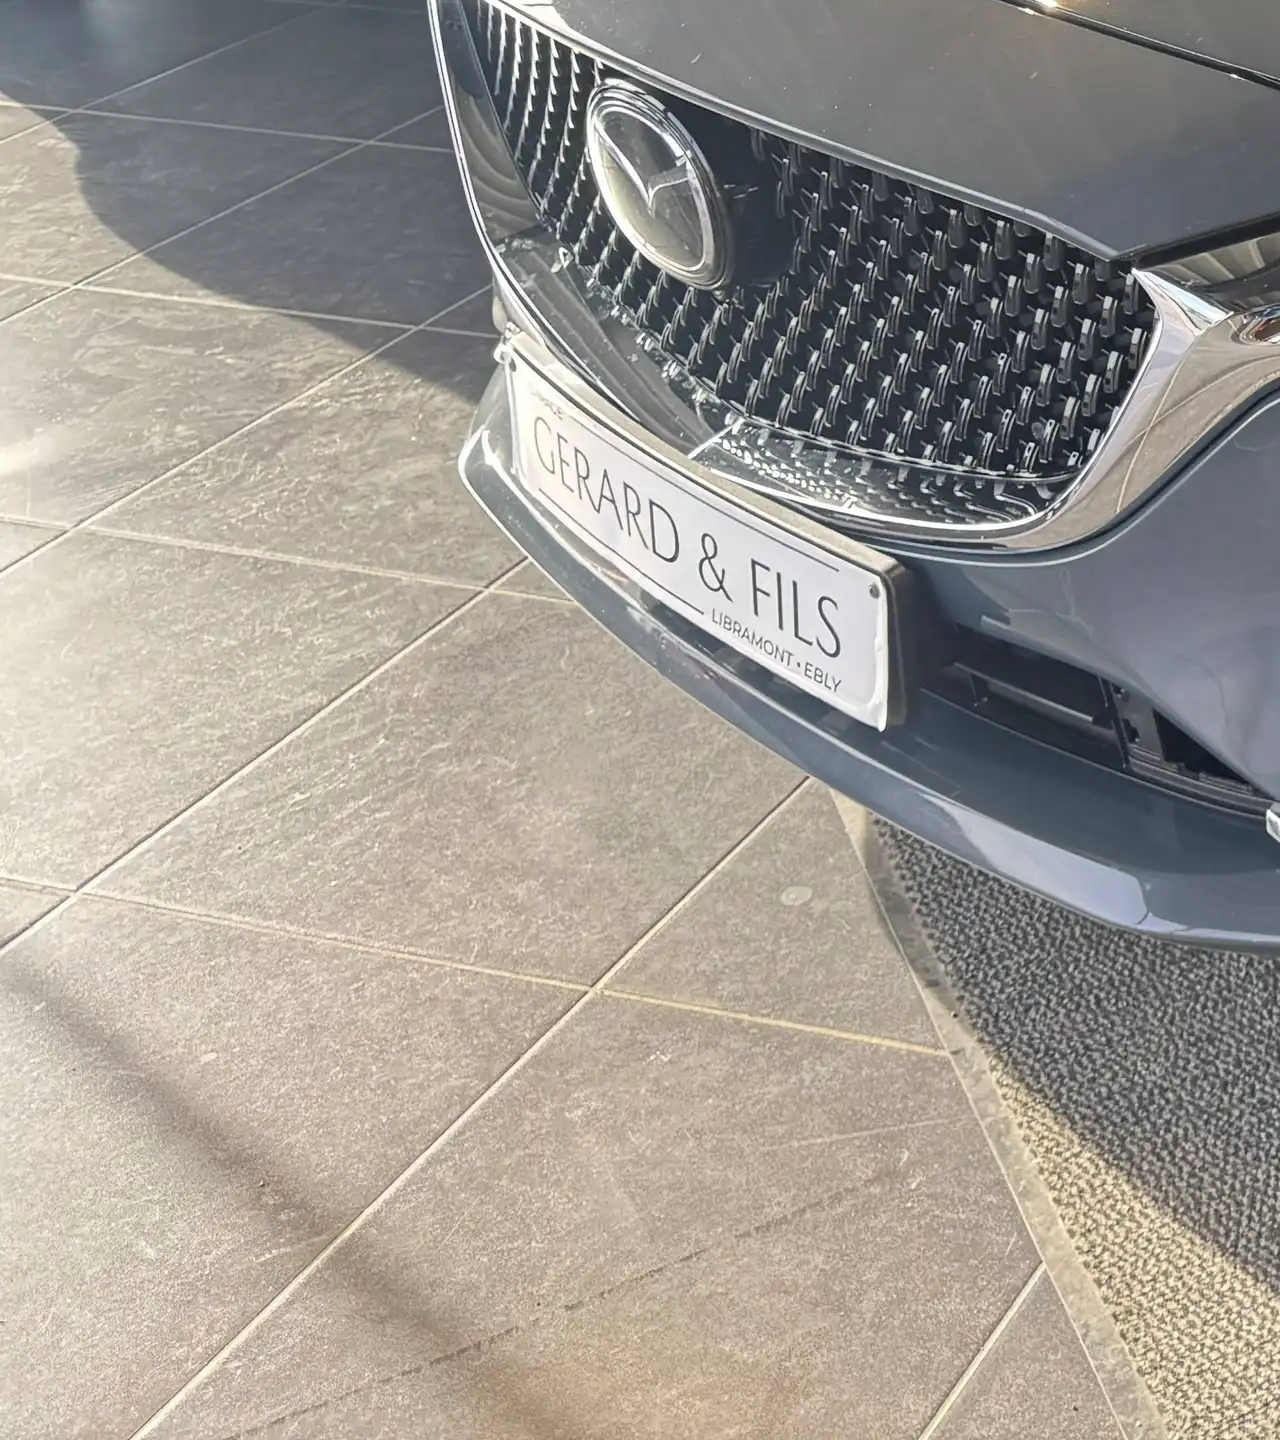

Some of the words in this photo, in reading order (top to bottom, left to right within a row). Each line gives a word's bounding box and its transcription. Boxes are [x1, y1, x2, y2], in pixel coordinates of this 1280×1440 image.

[534, 416, 681, 564] GERARD
[698, 532, 734, 603] &
[750, 557, 842, 659] FILS
[711, 607, 794, 668] LIBRAMONT
[803, 663, 843, 693] EBLY
